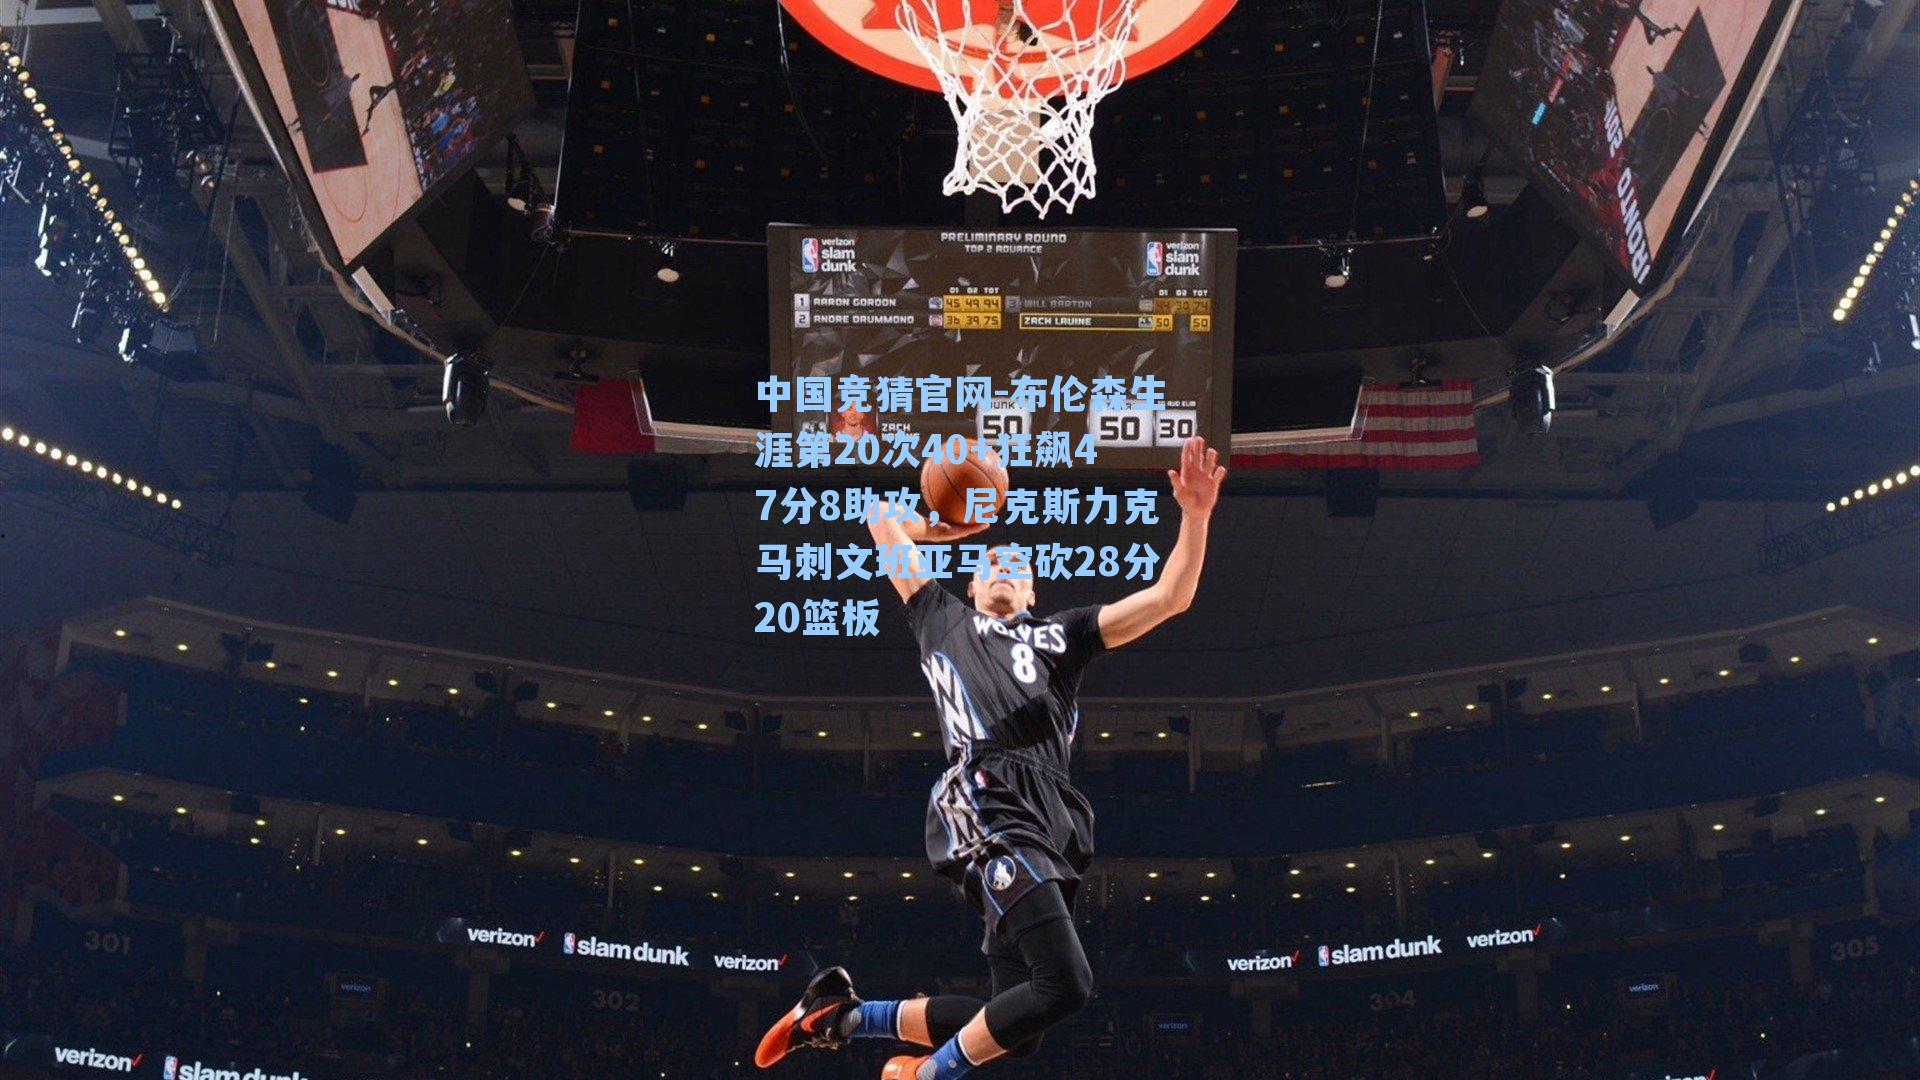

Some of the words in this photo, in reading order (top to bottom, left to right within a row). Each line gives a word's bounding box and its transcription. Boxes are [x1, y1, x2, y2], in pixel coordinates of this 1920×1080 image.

[821, 237, 855, 246] verizon
[940, 232, 1021, 242] PRELIMINARY
[1024, 233, 1067, 243] ROUND
[964, 244, 983, 253] TOP
[986, 245, 993, 253] 2
[995, 245, 1043, 253] ADVANCE
[1166, 241, 1199, 250] verizon
[821, 246, 855, 259] slam
[1165, 250, 1199, 263] slam
[821, 259, 857, 272] dunk
[1164, 263, 1200, 276] dunk
[983, 286, 999, 294] TOT
[813, 298, 850, 307] AARON
[853, 298, 897, 307] GORDON
[946, 299, 960, 308] 45
[965, 299, 979, 308] 49
[983, 299, 999, 308] 94
[1024, 300, 1048, 309] WILL
[1050, 300, 1092, 309] BARTON
[813, 316, 850, 325] ANDRE
[852, 315, 915, 325] DRUMMOND
[965, 316, 979, 325] 39
[983, 316, 999, 326] 75
[1024, 316, 1052, 325] ZACH
[1054, 316, 1092, 325] LAVINE
[1156, 318, 1170, 327] 50
[1193, 318, 1208, 327] 50
[983, 415, 1023, 439] 50
[1100, 416, 1140, 441] 50
[1159, 418, 1193, 438] 30
[973, 616, 1067, 654] WOLVES
[1010, 643, 1037, 684] 8
[84, 930, 131, 955] 301
[467, 927, 536, 948] verizon
[1466, 928, 1535, 949] verizon
[577, 936, 632, 960] slam
[632, 941, 690, 967] dunk
[1331, 944, 1385, 965] slam
[1385, 934, 1443, 960] dunk
[714, 953, 780, 972] verizon
[1227, 955, 1292, 972] verizon
[341, 983, 372, 992] verizon
[1629, 983, 1660, 991] verizon
[54, 1046, 133, 1073] verizon
[178, 1061, 241, 1080] slam
